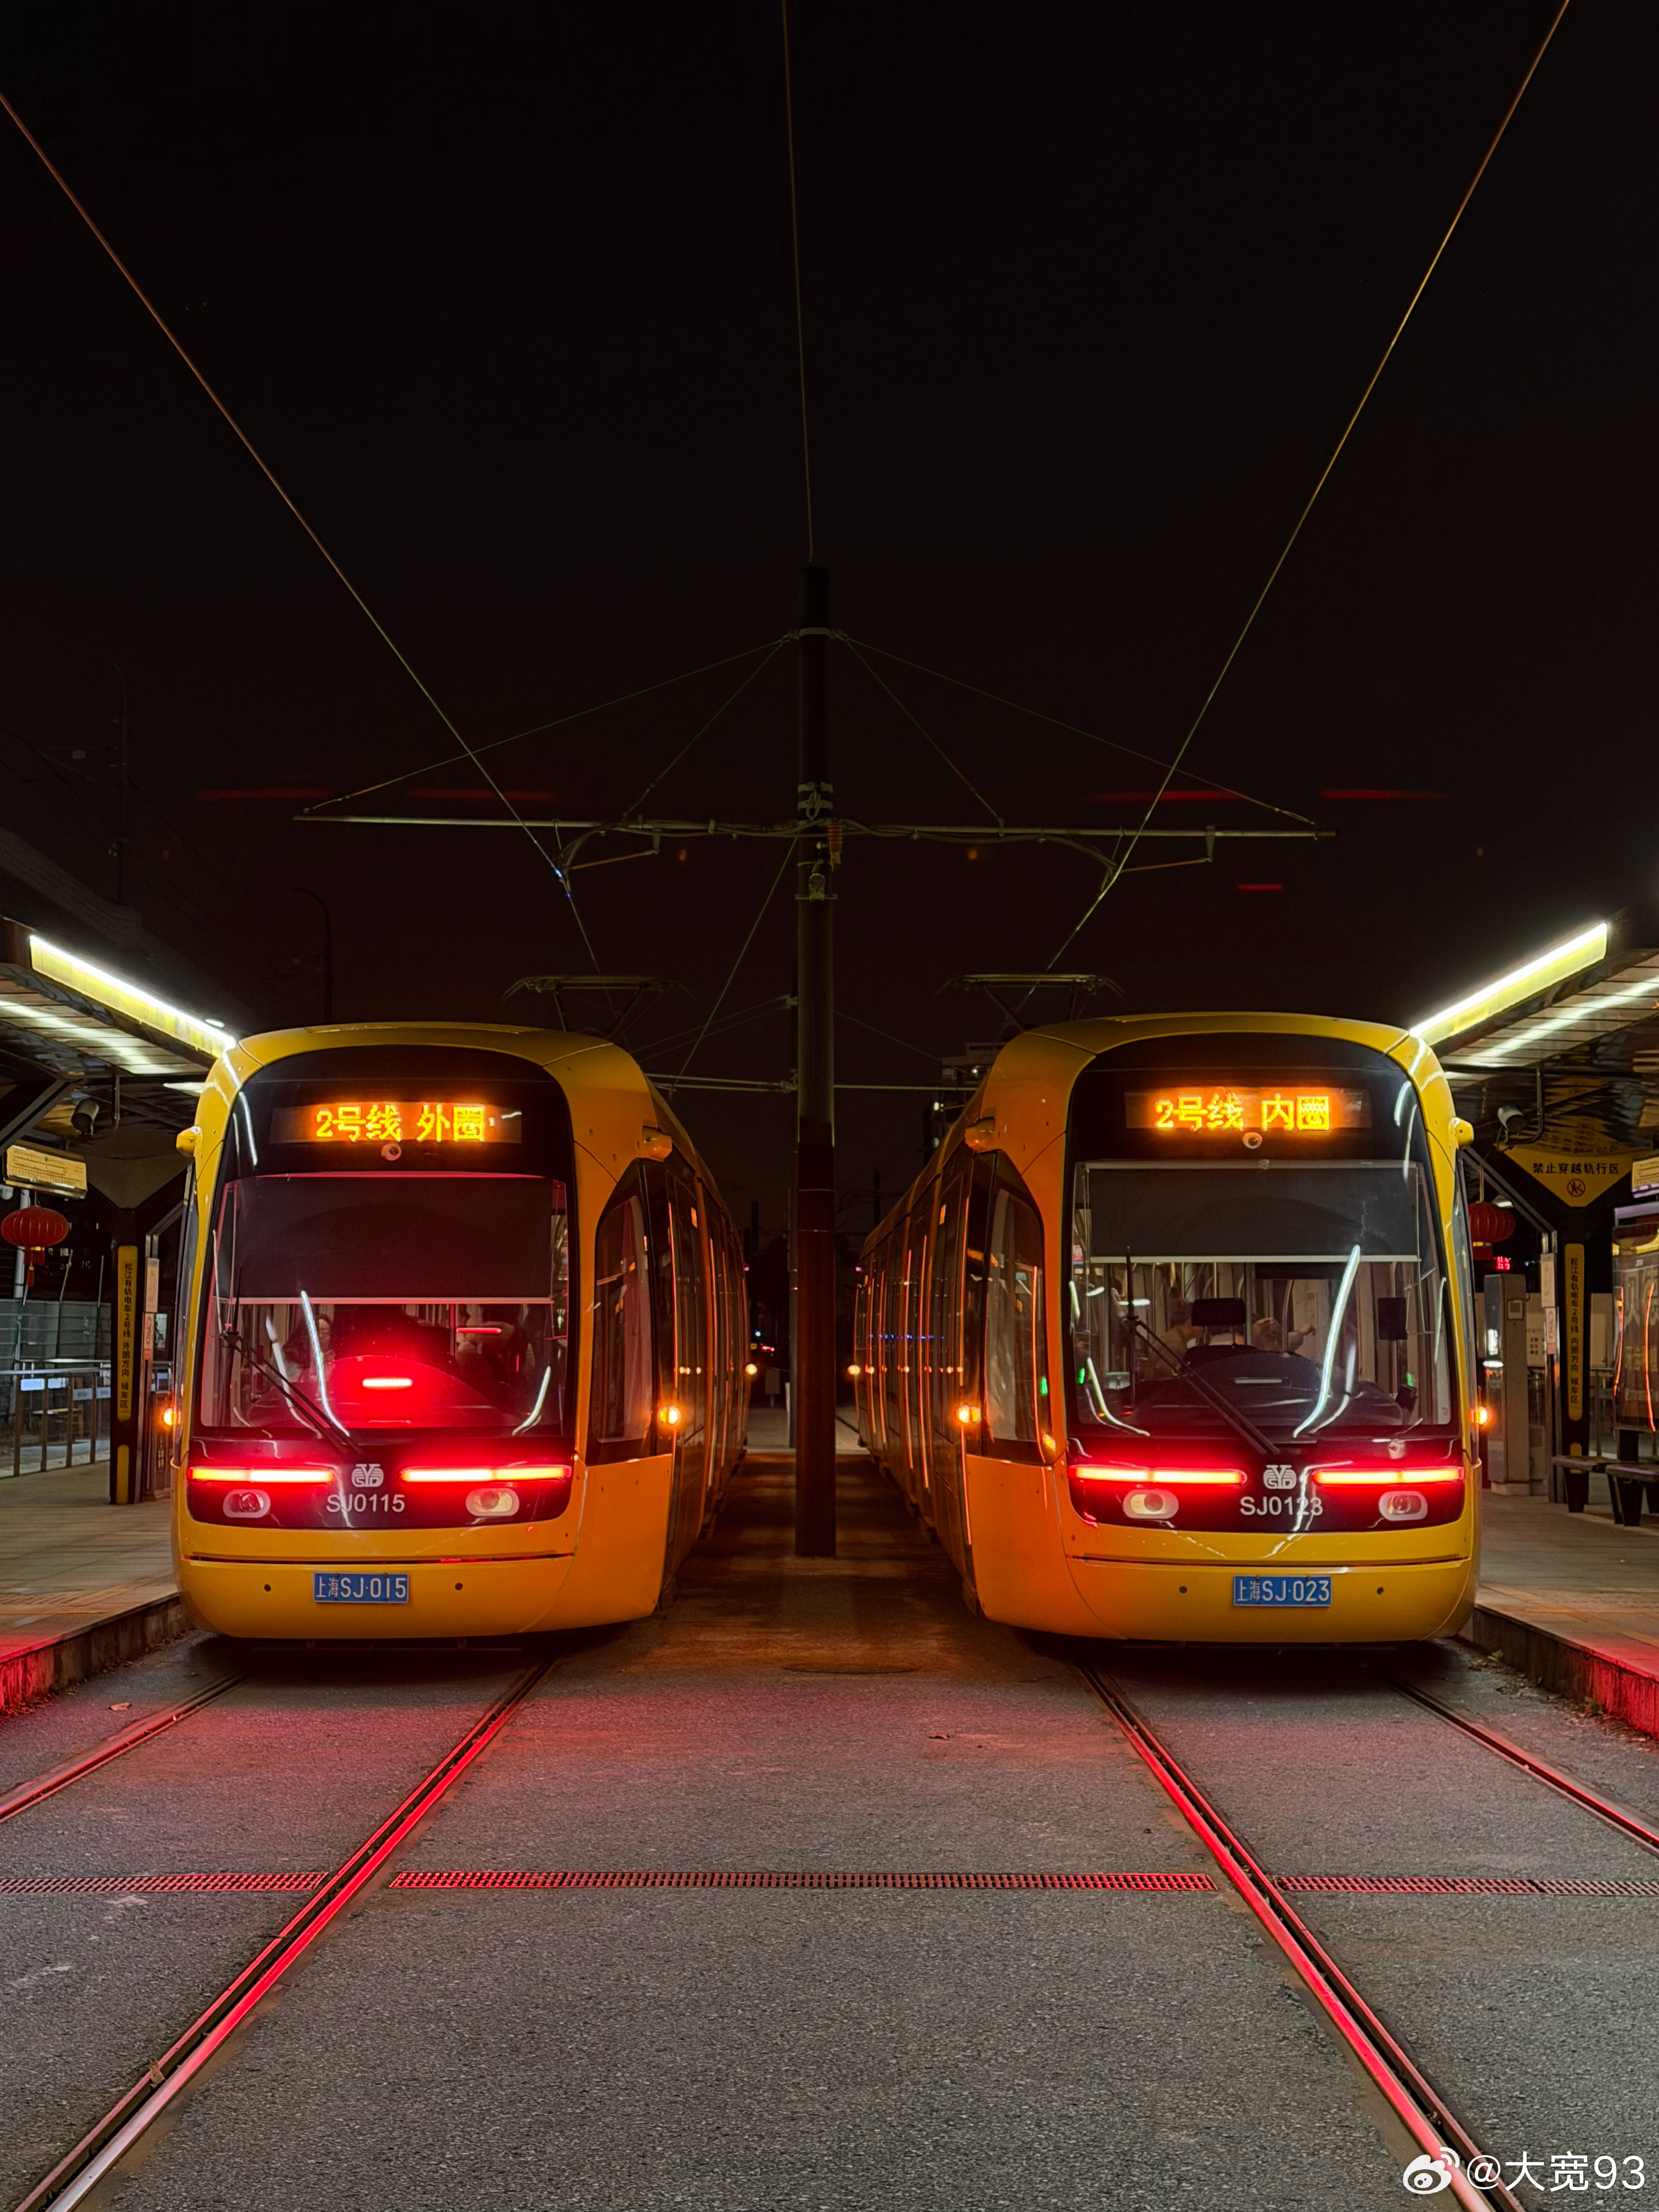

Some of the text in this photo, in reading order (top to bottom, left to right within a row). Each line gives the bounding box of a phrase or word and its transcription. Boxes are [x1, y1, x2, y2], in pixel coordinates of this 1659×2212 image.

[1154, 1092, 1330, 1132] 2号线 内圈
[316, 1103, 486, 1142] 2号线 外圈
[1533, 1163, 1619, 1175] 禁止穿越轨行区
[326, 1494, 405, 1513] SJ0115
[1240, 1496, 1323, 1516] SJ0123
